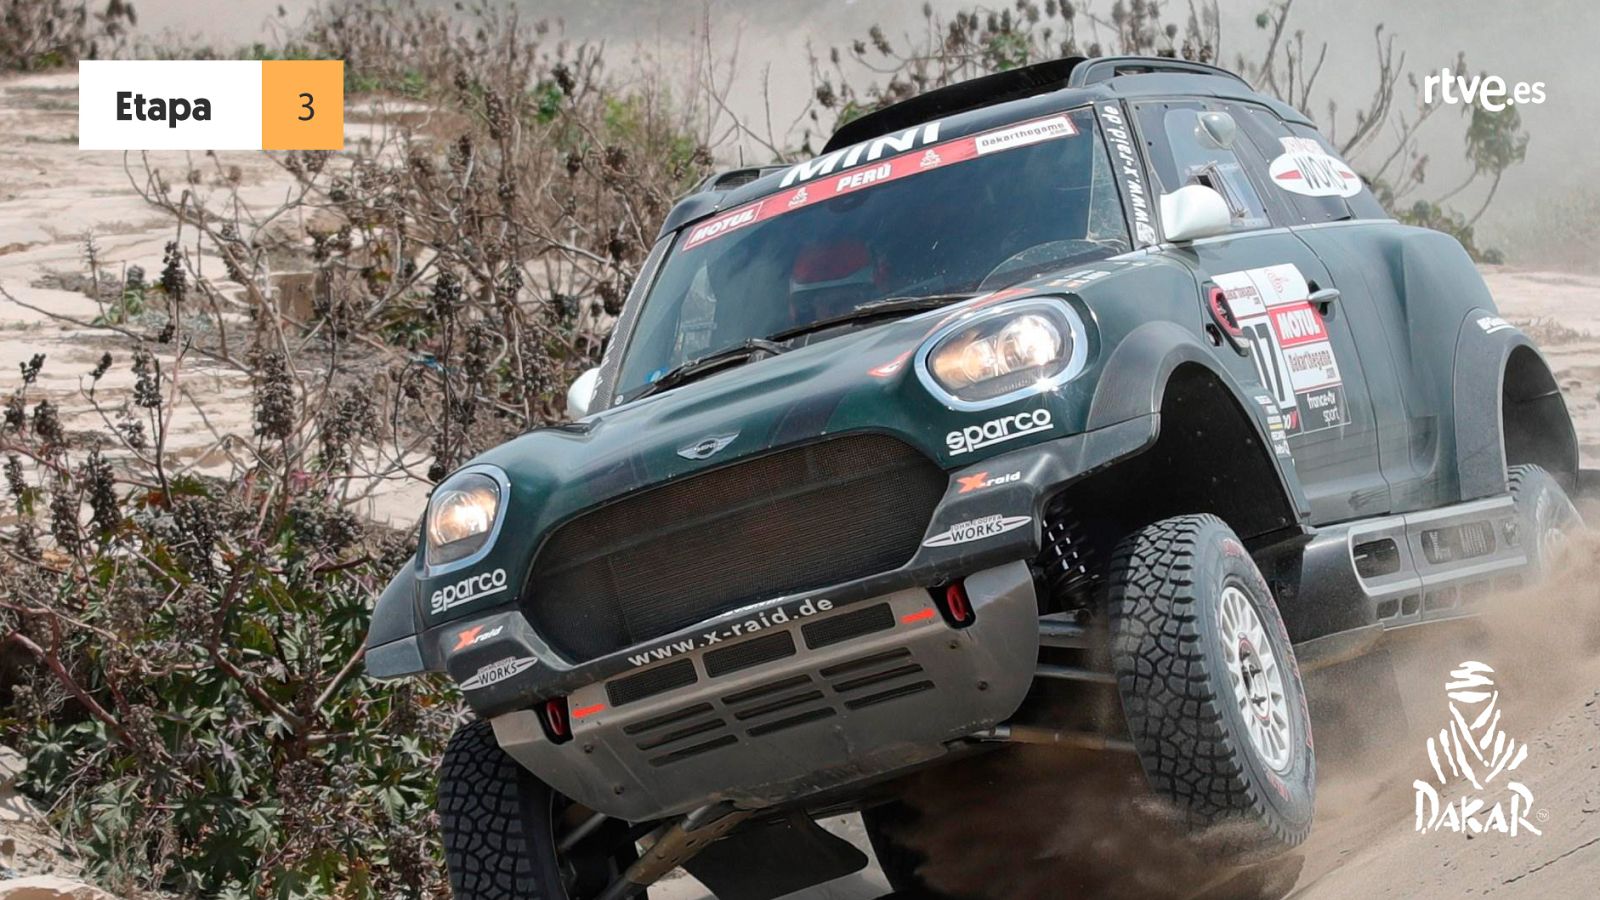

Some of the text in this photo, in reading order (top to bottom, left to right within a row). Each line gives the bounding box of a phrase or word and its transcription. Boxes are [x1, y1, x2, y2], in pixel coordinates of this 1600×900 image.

[779, 122, 941, 189] MINI
[1101, 105, 1149, 222] www.x-raid.de
[689, 208, 755, 244] MOTUL
[1276, 308, 1321, 340] MOTUL
[945, 408, 1052, 453] sparco
[951, 521, 1003, 542] WORKS
[431, 568, 507, 613] sparco
[627, 598, 834, 666] www.x-raid.de
[478, 662, 517, 685] WORKS
